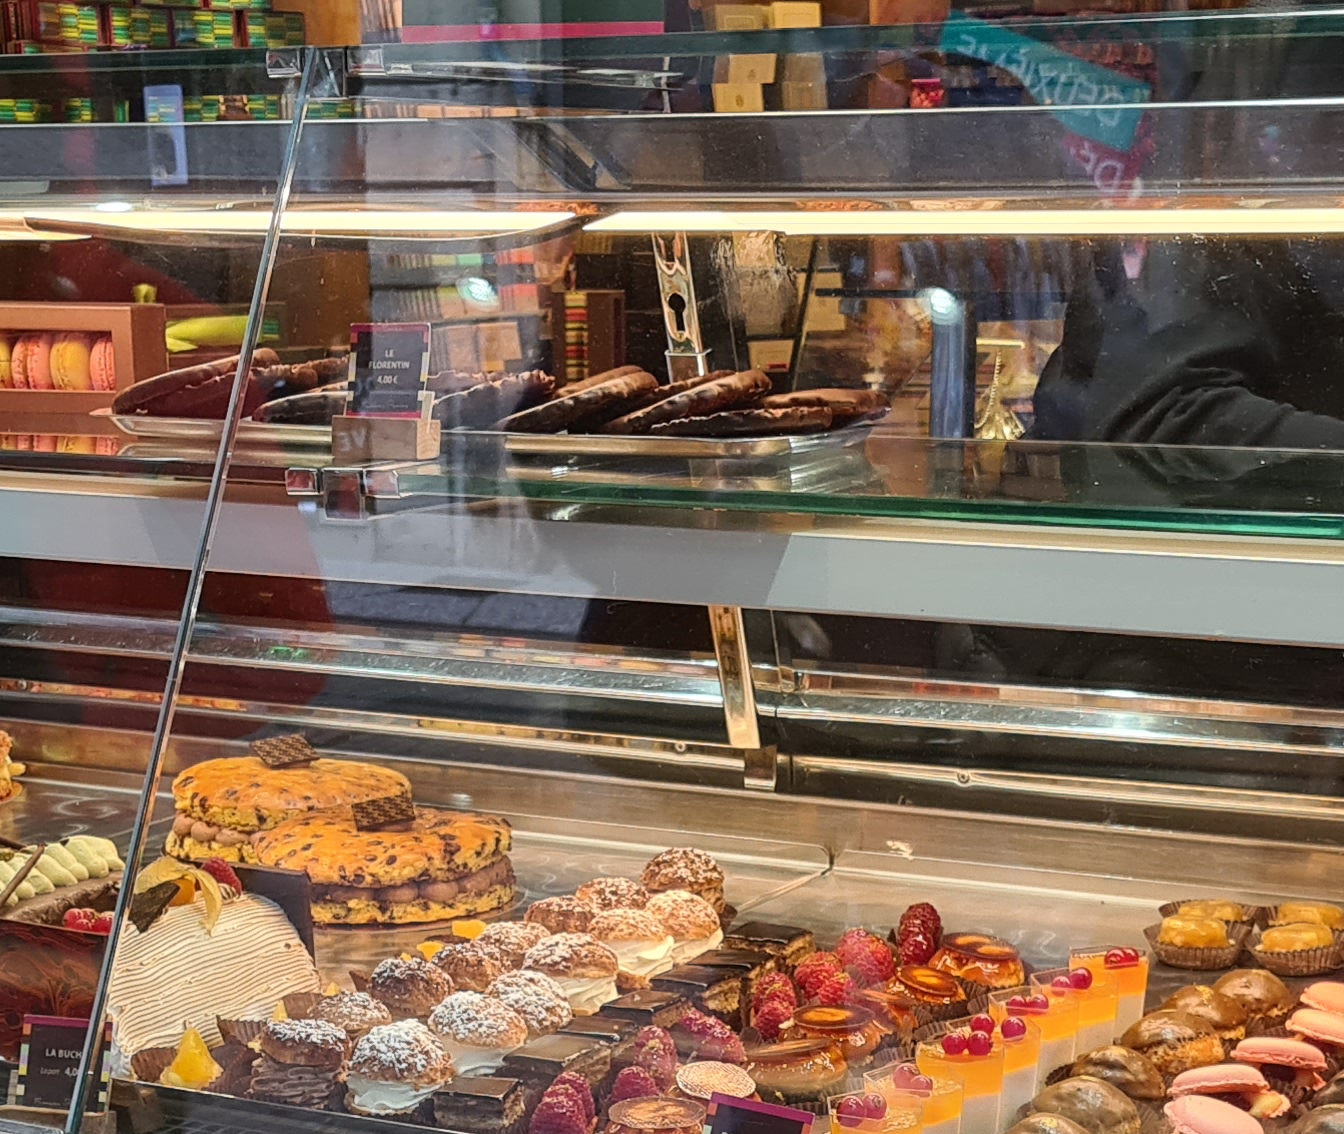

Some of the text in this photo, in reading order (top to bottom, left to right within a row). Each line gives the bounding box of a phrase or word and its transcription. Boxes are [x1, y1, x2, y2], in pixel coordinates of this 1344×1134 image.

[384, 349, 395, 358] LE
[368, 361, 410, 370] FLORENTIN
[45, 1048, 83, 1059] LA BUCH
